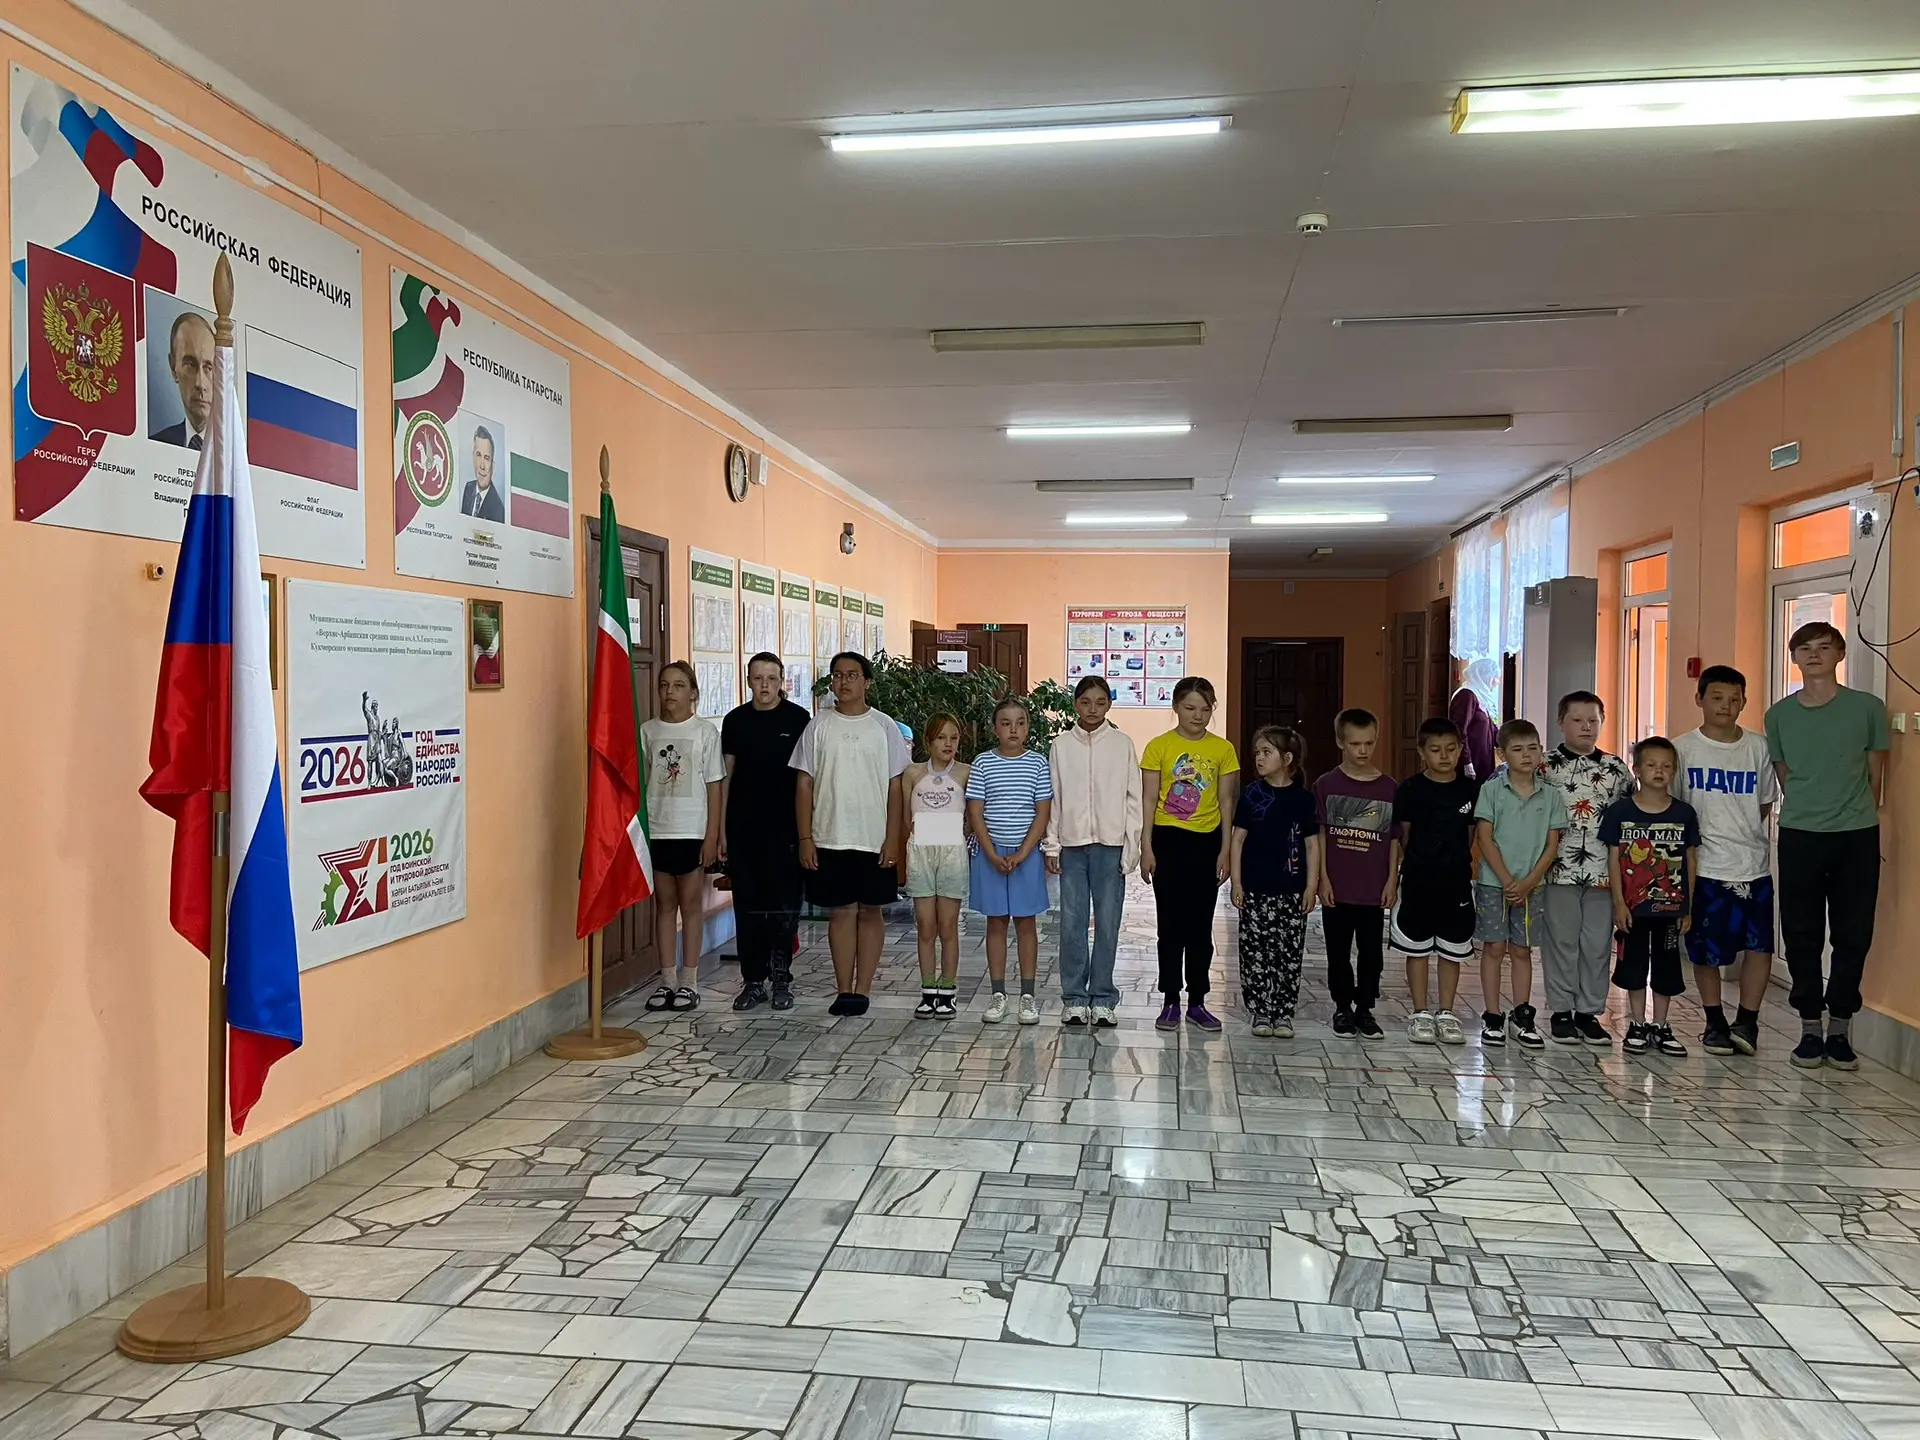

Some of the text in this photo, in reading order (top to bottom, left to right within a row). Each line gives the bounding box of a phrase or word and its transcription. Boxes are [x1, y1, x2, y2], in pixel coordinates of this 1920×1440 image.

[142, 195, 352, 309] РОССИЙСКАЯ ФЕДЕРАЦИЯ
[463, 347, 563, 407] РЕСПУБЛИКА ТАТАРСТАН
[77, 446, 97, 457] ГЕРБ
[33, 449, 136, 476] РОССИЙСКОЙ ФЕДЕРАЦИИ
[154, 491, 188, 507] Владимир
[280, 499, 344, 519] РОССИЙСКОЙ ФЕДЕРАЦИИ
[415, 730, 434, 744] ГОД
[415, 743, 461, 759] ЕДИНСТВА
[300, 745, 367, 791] 2026
[415, 757, 456, 773] НАРОДОВ
[416, 772, 452, 788] РОССИИ
[1687, 767, 1758, 794] ЛДПР
[1329, 826, 1382, 842] EMOTIONAL
[1621, 829, 1682, 841] IRON MAN
[390, 828, 434, 862] 2026
[389, 855, 432, 874] ГОД ВОИНСКОЙ
[390, 862, 450, 885] И ТРУДОВОЙ ДОБЛЕСТИ
